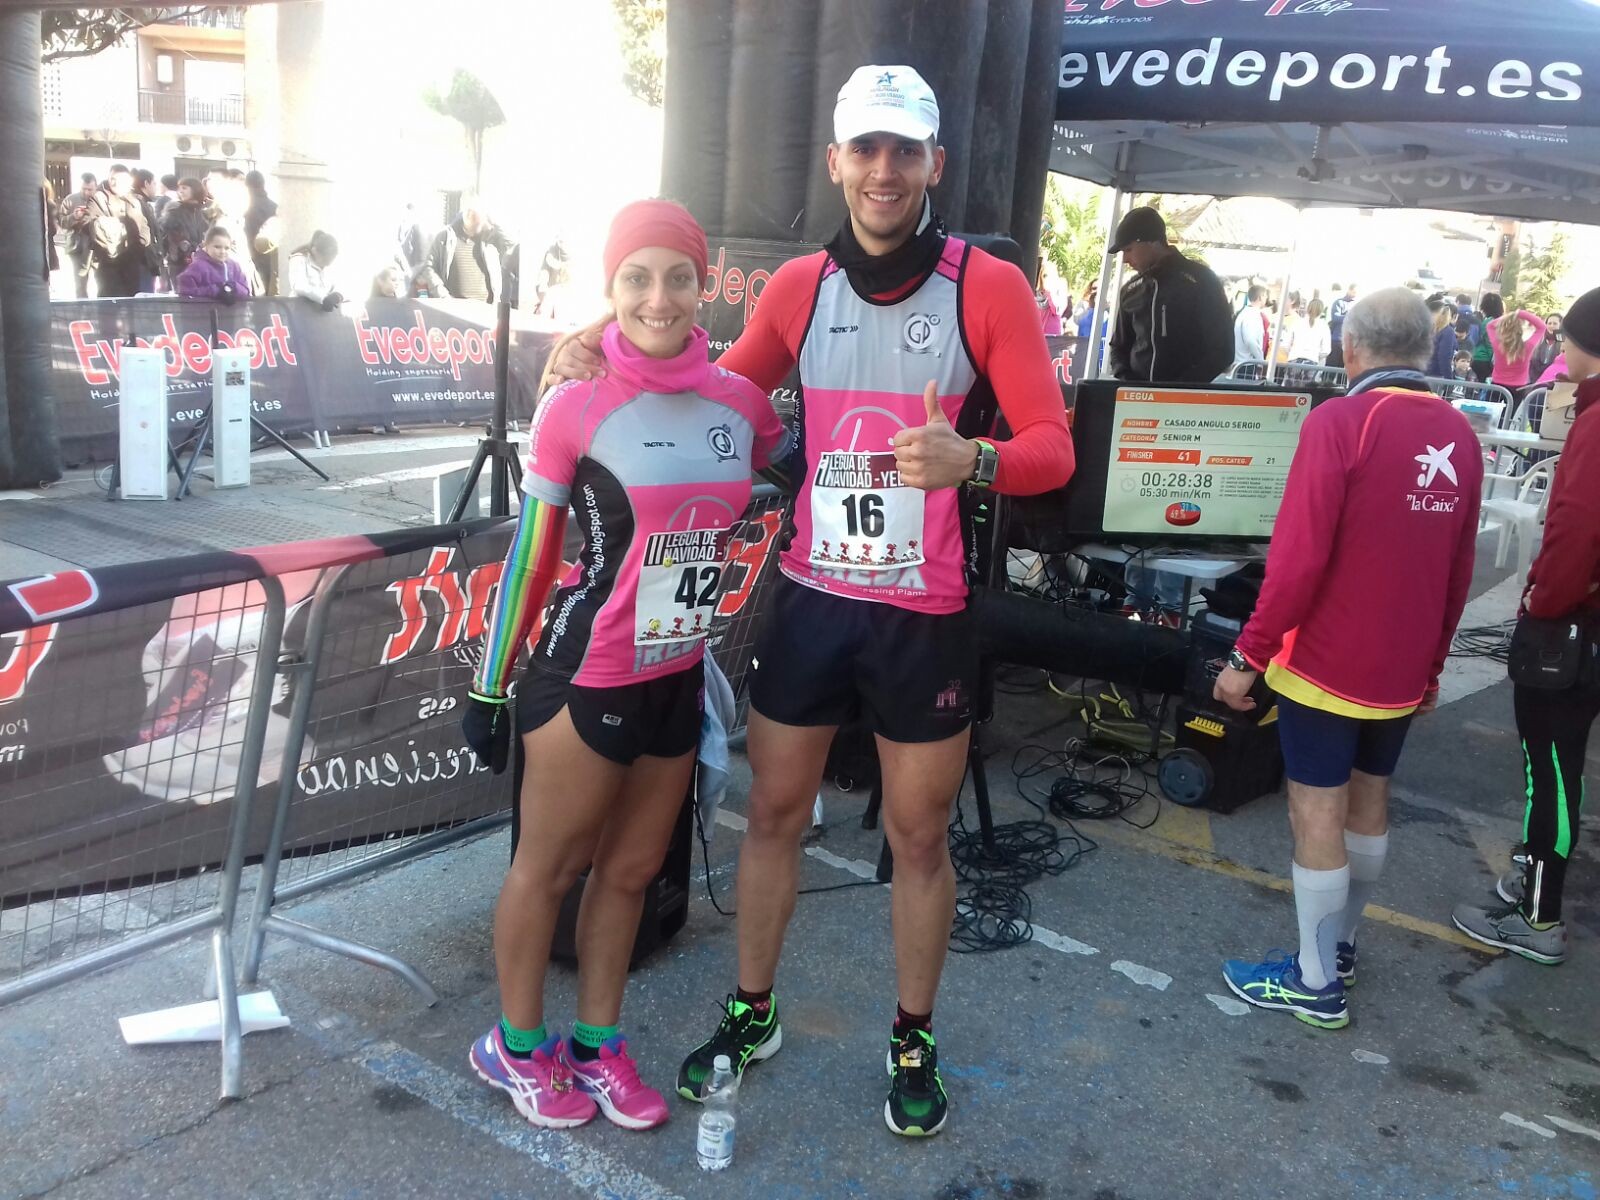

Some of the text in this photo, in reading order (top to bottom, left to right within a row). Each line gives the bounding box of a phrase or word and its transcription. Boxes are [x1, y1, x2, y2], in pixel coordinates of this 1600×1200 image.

[1057, 37, 1583, 101] evedeport.es
[353, 309, 496, 381] Evedepor
[1123, 391, 1155, 401] LEGUA
[1164, 419, 1197, 427] CASADO
[1198, 420, 1230, 428] ANGULO
[1232, 421, 1261, 429] SERGIO
[1162, 433, 1192, 441] SENIOR
[830, 455, 856, 470] LEGUA
[857, 456, 871, 471] DE
[1126, 450, 1190, 461] FINISHER 41
[1266, 457, 1276, 465] 21
[827, 471, 872, 487] NAVIDAD
[880, 471, 905, 487] YEL
[1141, 472, 1213, 488] 00:28:38
[1139, 488, 1168, 498] 05:30
[1169, 488, 1212, 500] min/Km
[841, 493, 885, 538] 16
[666, 532, 700, 548] LEGUA
[702, 531, 719, 546] DE
[664, 545, 716, 564] NAVIDAD
[674, 566, 721, 609] 42
